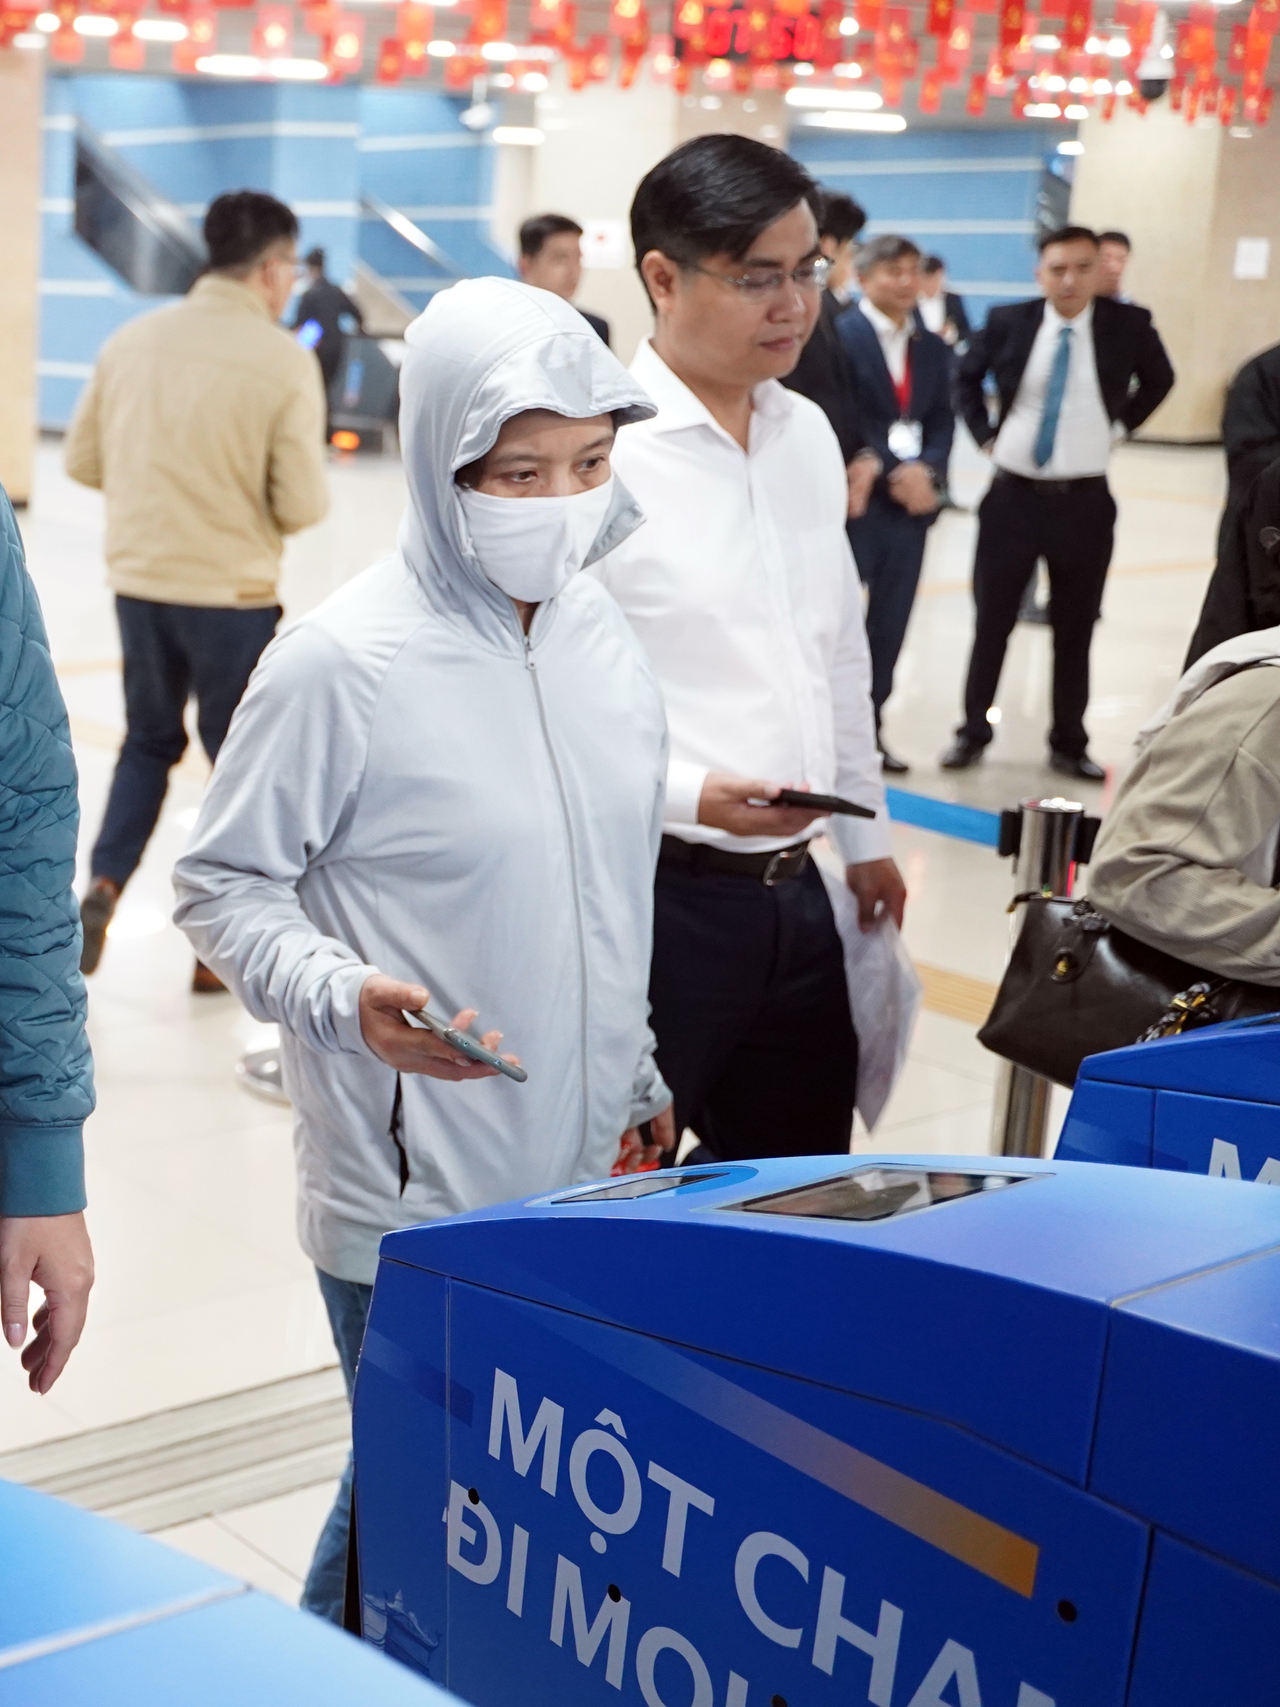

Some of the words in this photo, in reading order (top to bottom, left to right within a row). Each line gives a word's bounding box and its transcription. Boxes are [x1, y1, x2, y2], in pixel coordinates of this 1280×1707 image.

[442, 1479, 529, 1618] ĐI
[488, 1367, 715, 1578] MỘT
[735, 1531, 1057, 1707] CHA
